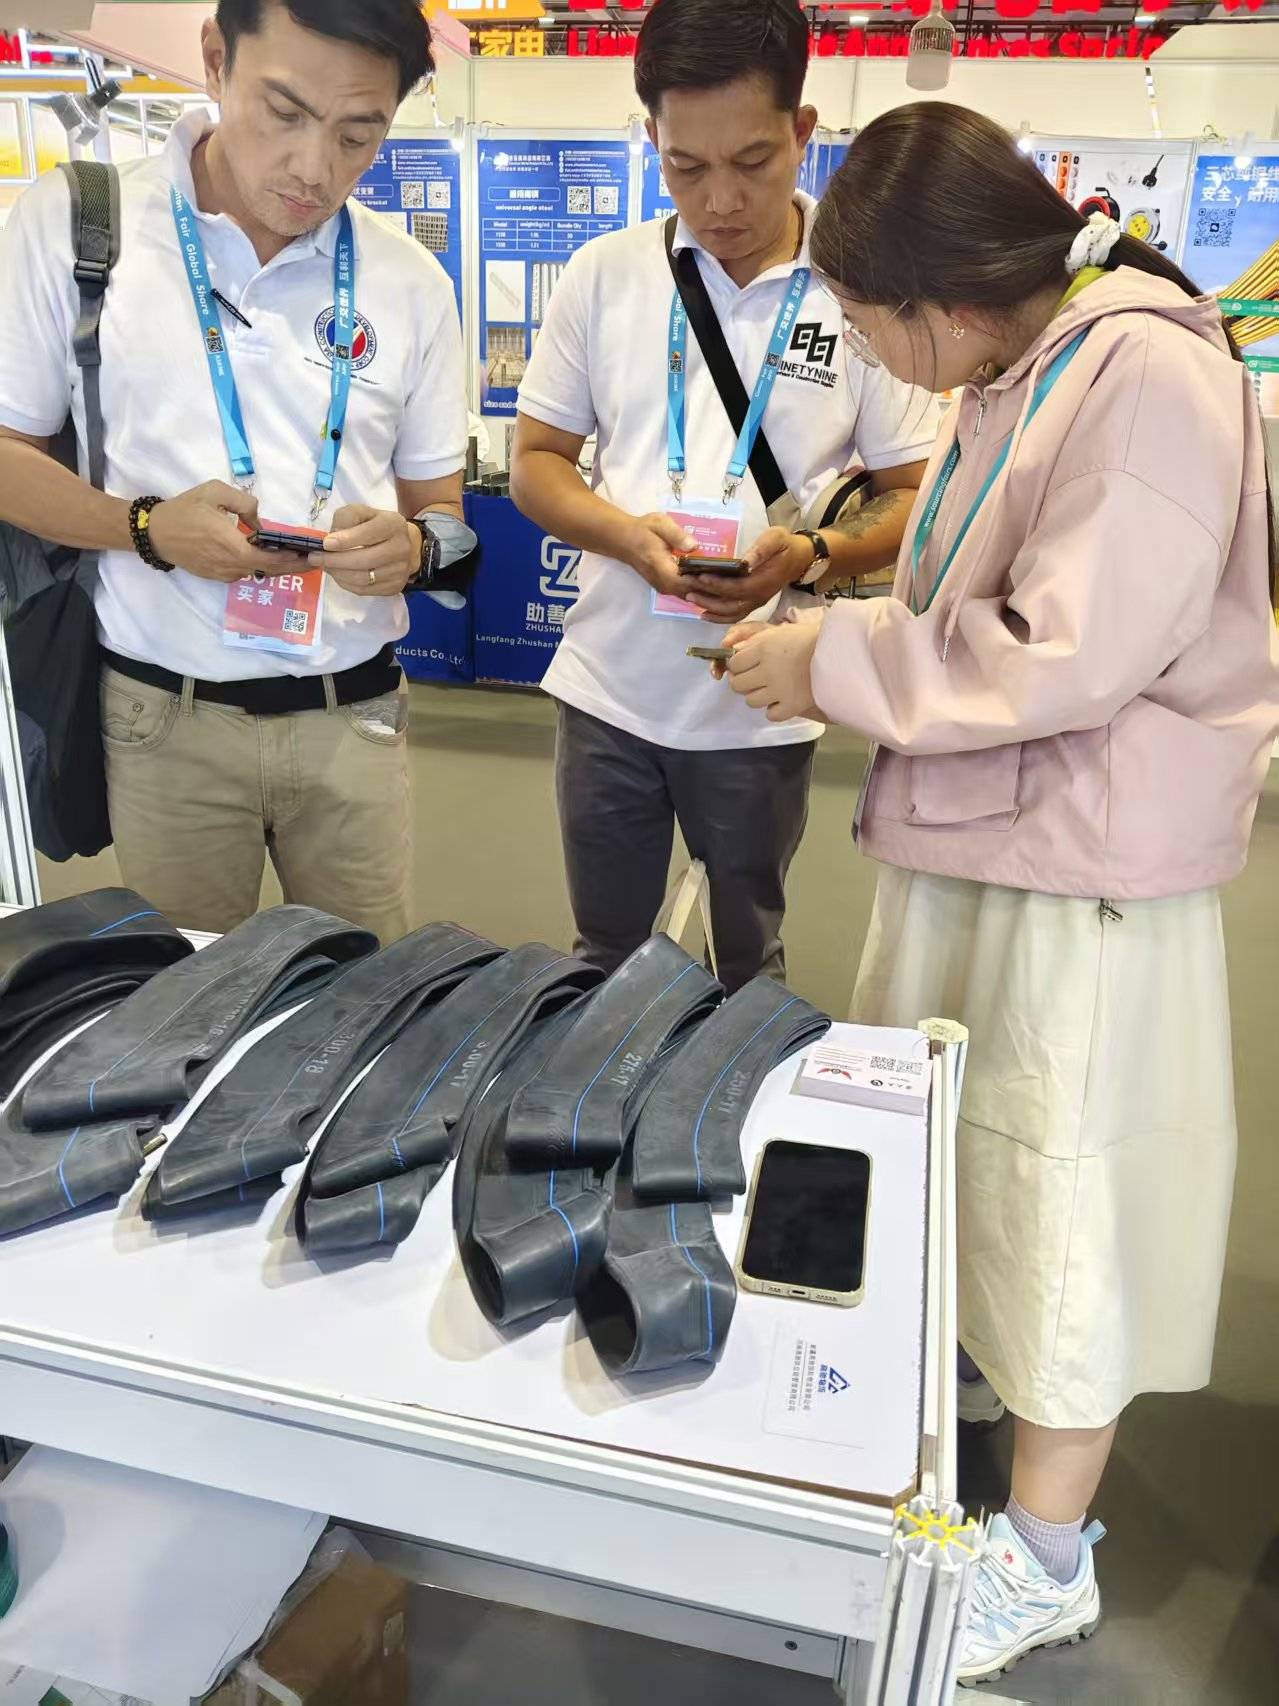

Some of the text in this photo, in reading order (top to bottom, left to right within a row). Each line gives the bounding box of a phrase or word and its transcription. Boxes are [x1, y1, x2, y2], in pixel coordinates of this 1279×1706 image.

[1200, 186, 1232, 202] 安全
[179, 216, 191, 239] Fair
[186, 244, 203, 279] Global
[195, 284, 210, 316] Share
[672, 316, 682, 342] Share
[780, 360, 839, 384] INETYNINE
[236, 585, 274, 606] 买家
[476, 634, 554, 648] Langfang Zhushan
[395, 646, 428, 658] ducts
